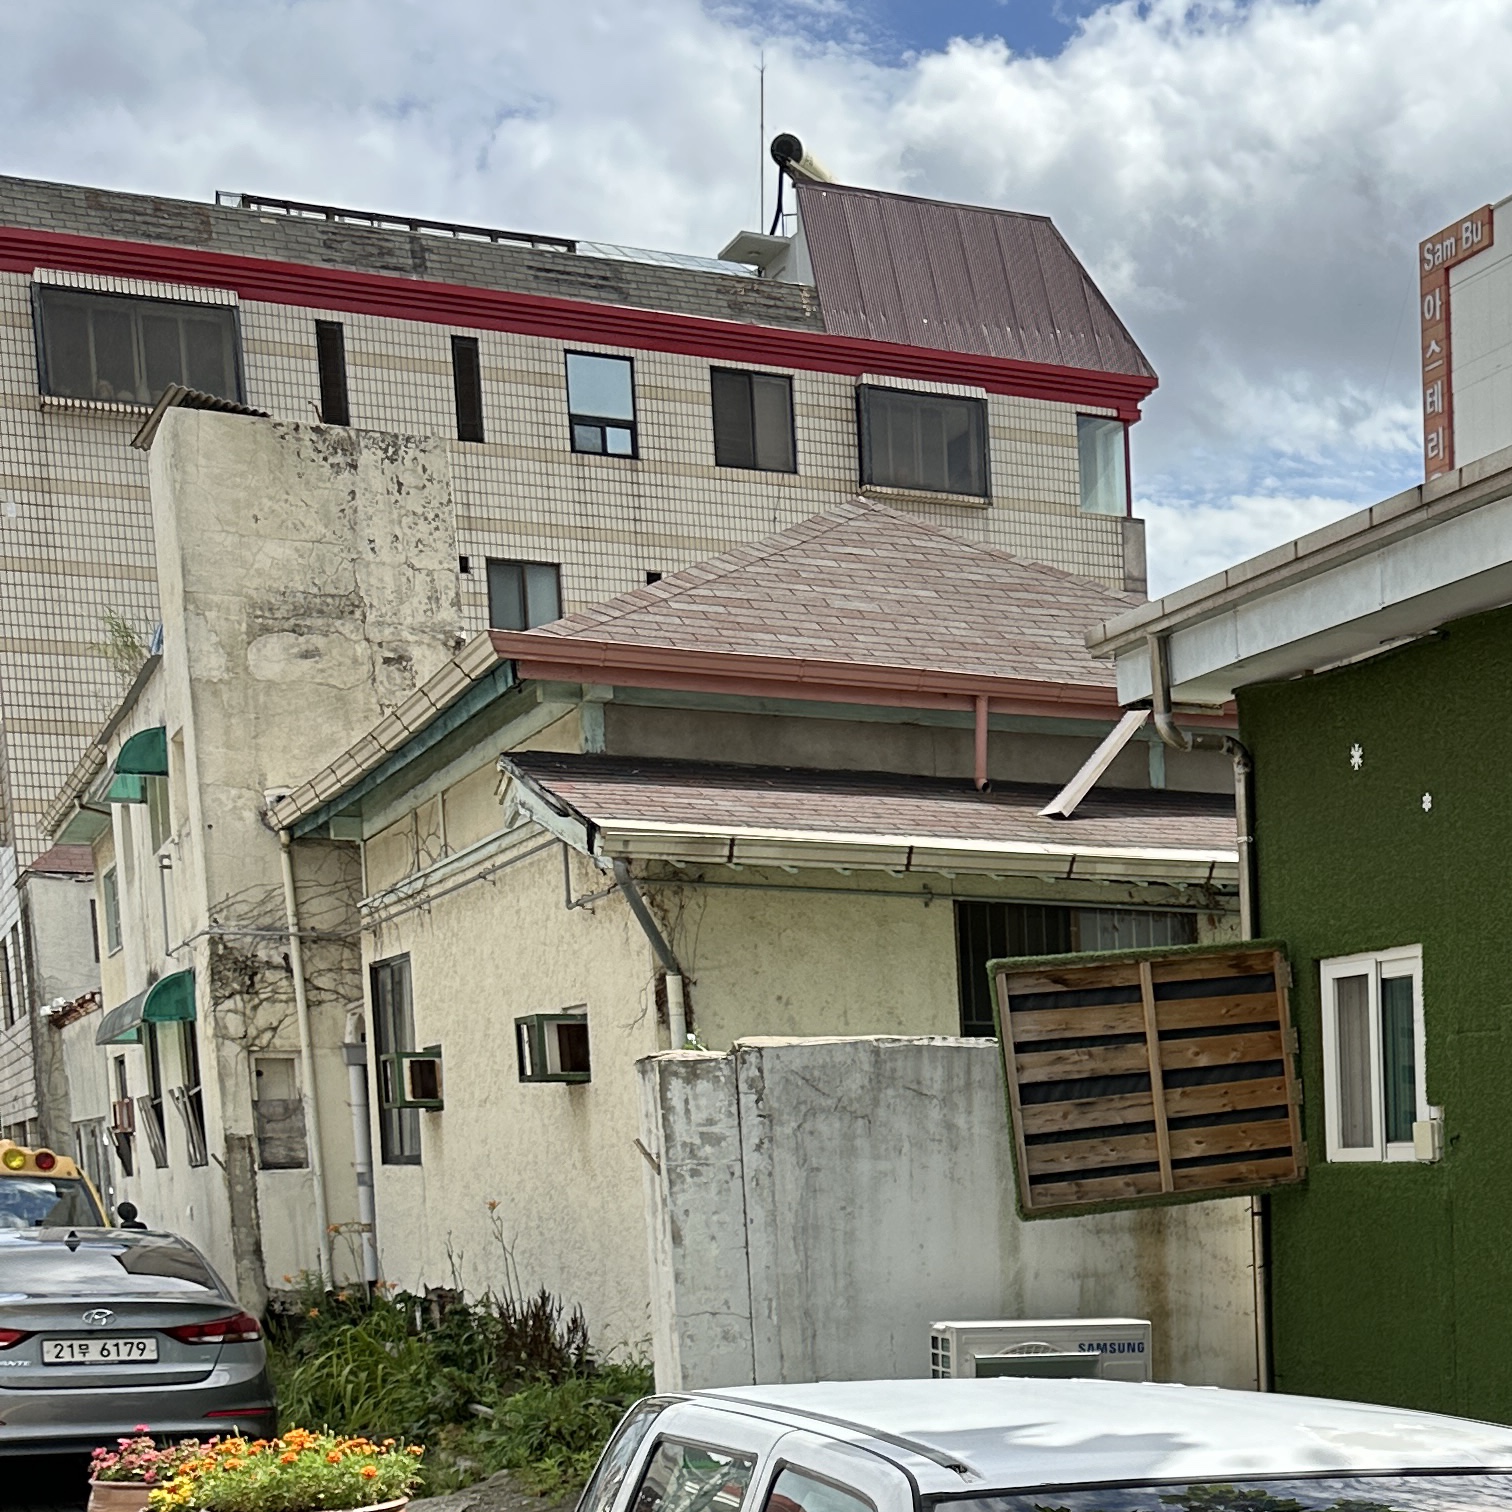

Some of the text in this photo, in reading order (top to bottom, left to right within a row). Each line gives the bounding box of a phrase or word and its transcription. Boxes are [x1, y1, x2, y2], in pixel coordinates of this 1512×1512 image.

[1424, 221, 1482, 271] Sam Bu
[1423, 288, 1445, 481] 아스테리
[54, 1342, 147, 1359] 21무 6179
[1078, 1342, 1145, 1353] SAMSUNG
